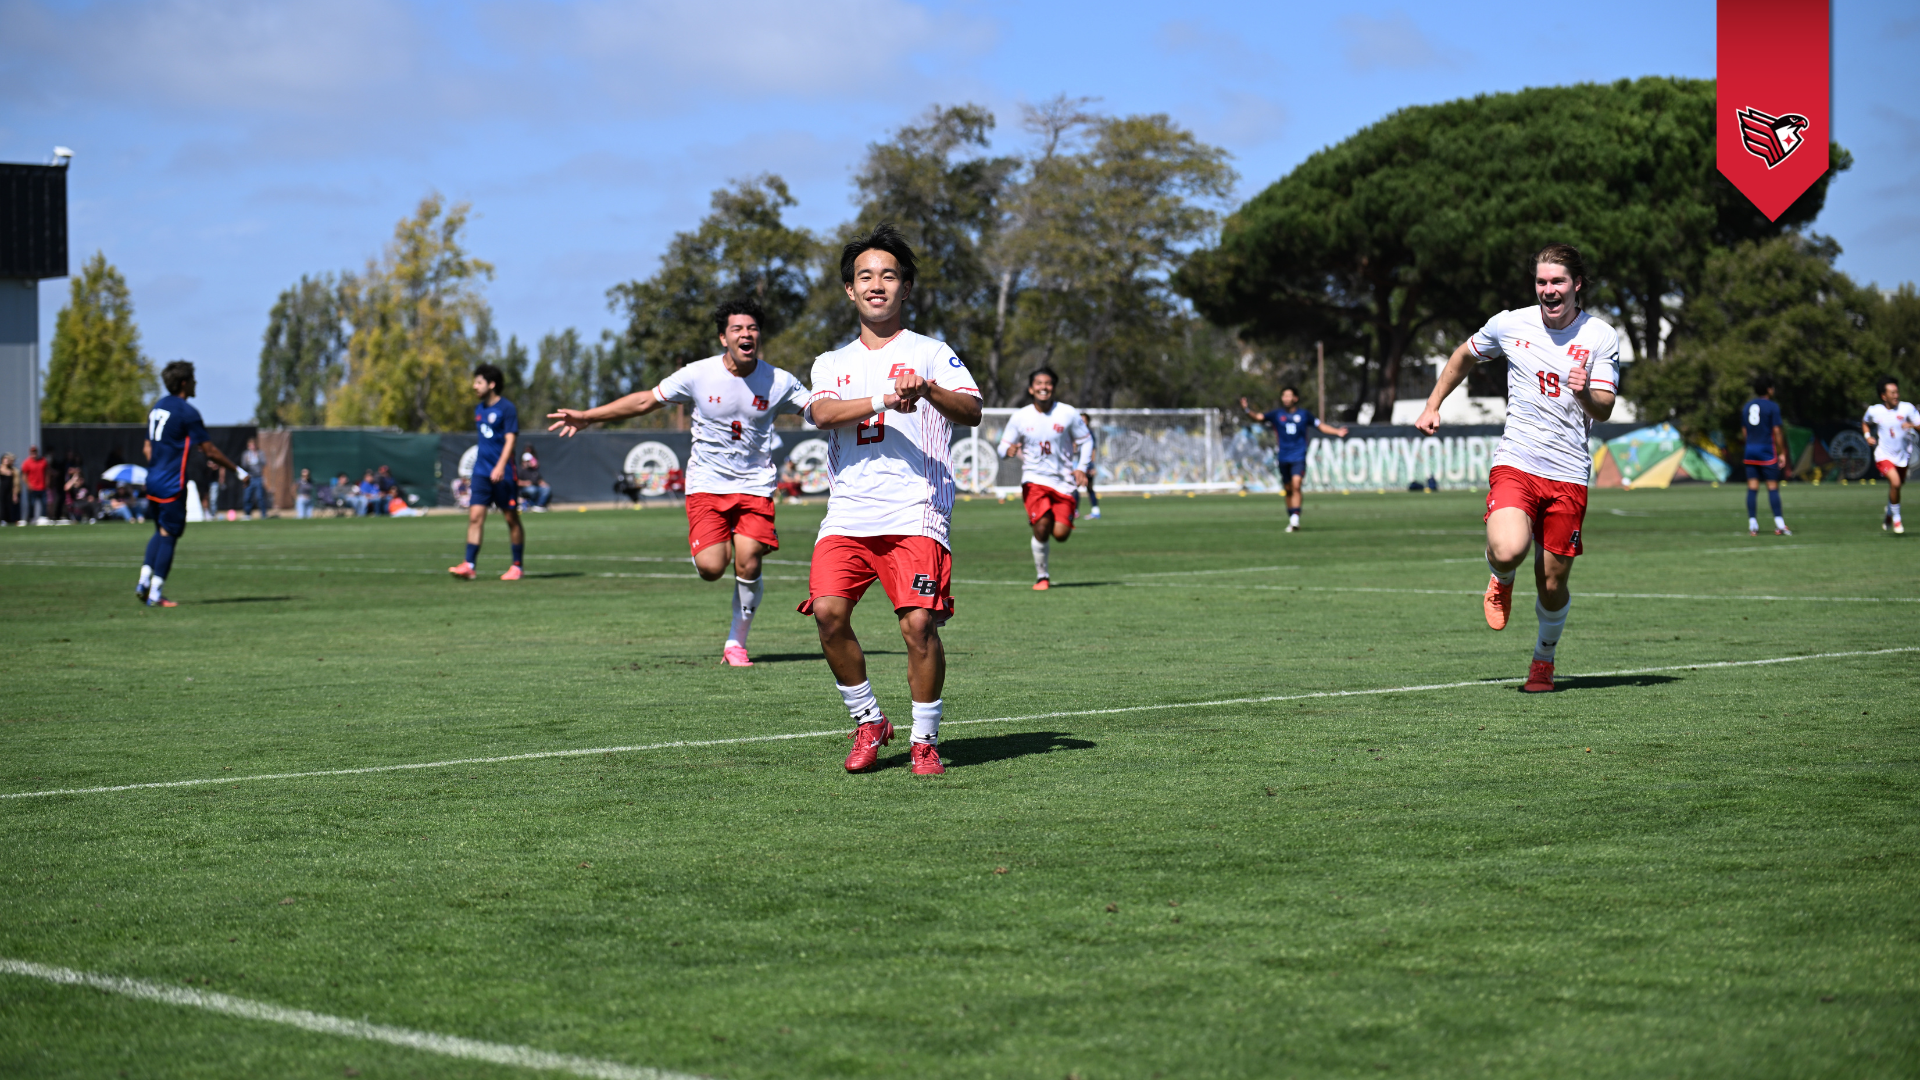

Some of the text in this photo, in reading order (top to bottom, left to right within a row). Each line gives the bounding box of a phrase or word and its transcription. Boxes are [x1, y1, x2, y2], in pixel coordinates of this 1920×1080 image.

[1536, 370, 1561, 398] 19
[752, 395, 769, 411] EB
[1749, 404, 1760, 426] 8
[149, 408, 171, 441] 17
[731, 421, 742, 440] 9
[857, 411, 885, 446] 23
[1303, 436, 1503, 484] KNOWYOUR
[911, 573, 937, 597] EB
